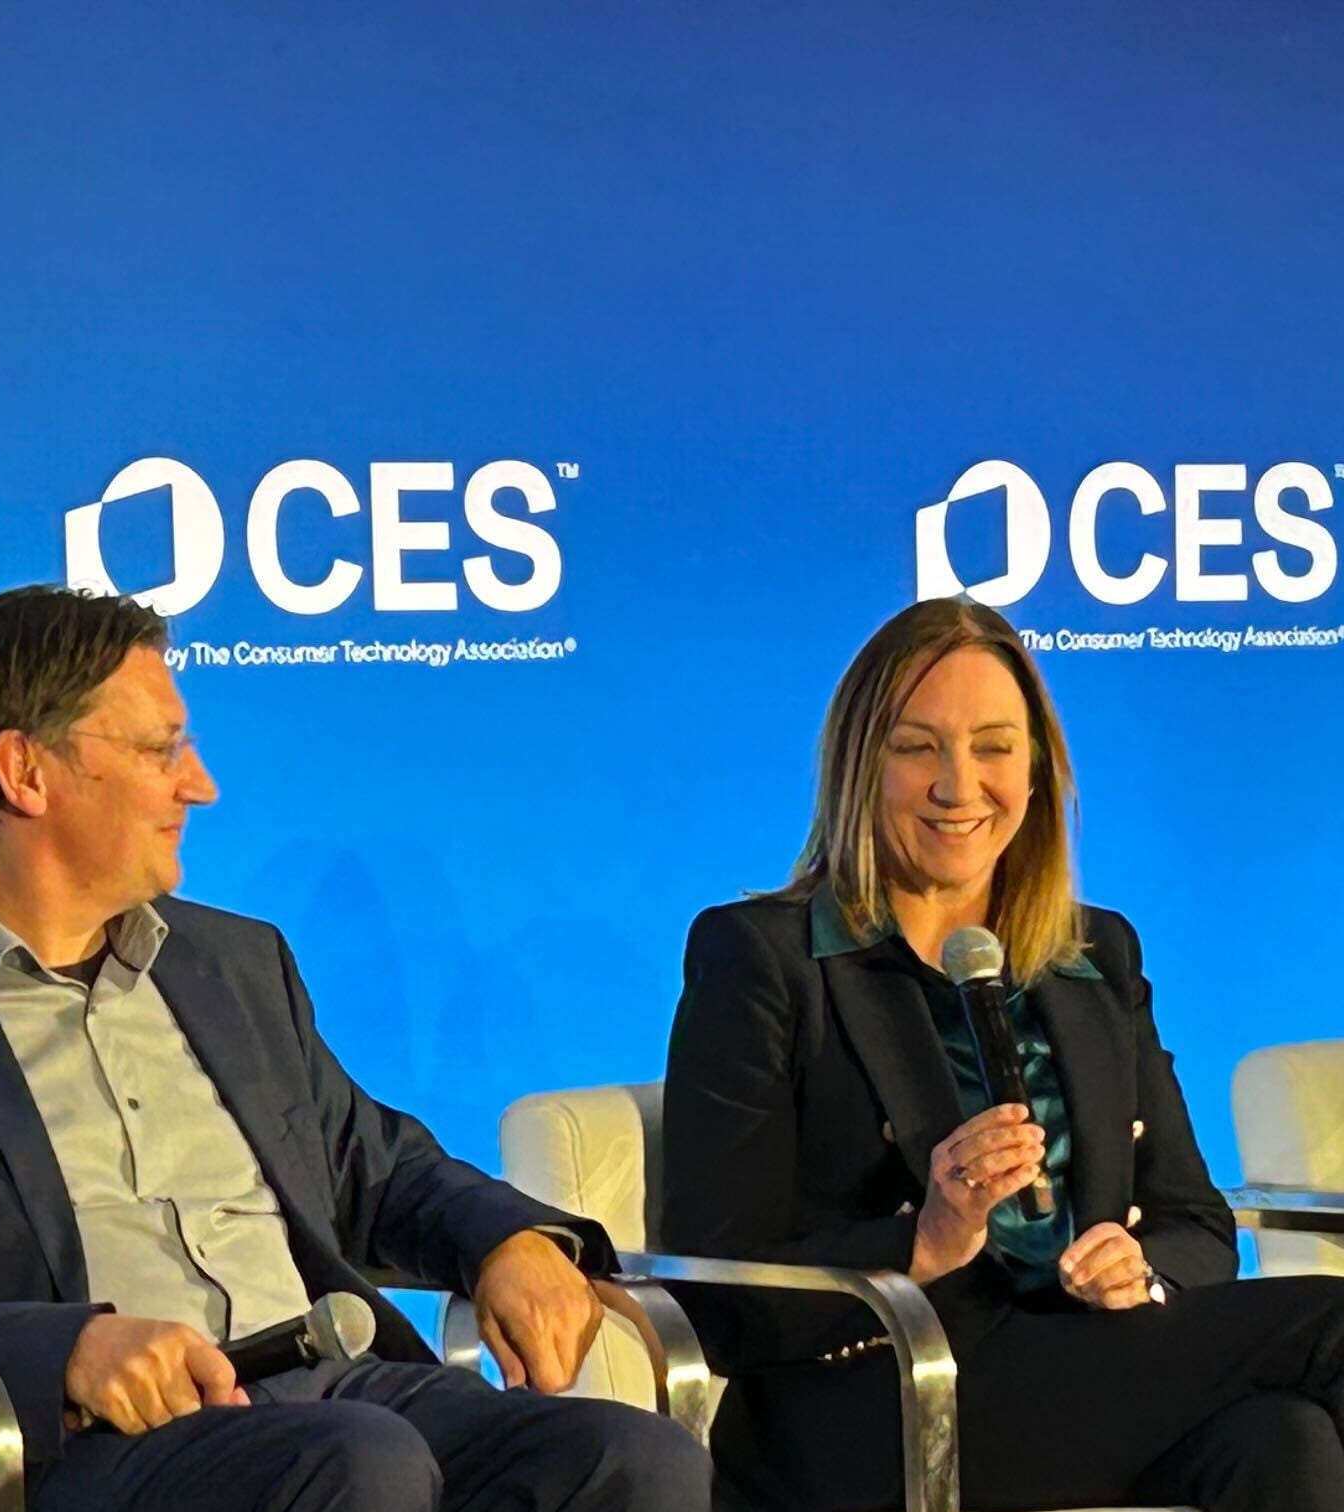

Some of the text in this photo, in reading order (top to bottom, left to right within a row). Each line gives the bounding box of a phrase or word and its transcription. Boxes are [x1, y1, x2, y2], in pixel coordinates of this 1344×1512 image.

[190, 641, 231, 665] The
[233, 640, 338, 665] Consumer
[340, 639, 452, 667] Technology
[1019, 629, 1054, 651] The
[1056, 628, 1145, 651] Consumer
[1146, 627, 1242, 653] Technology
